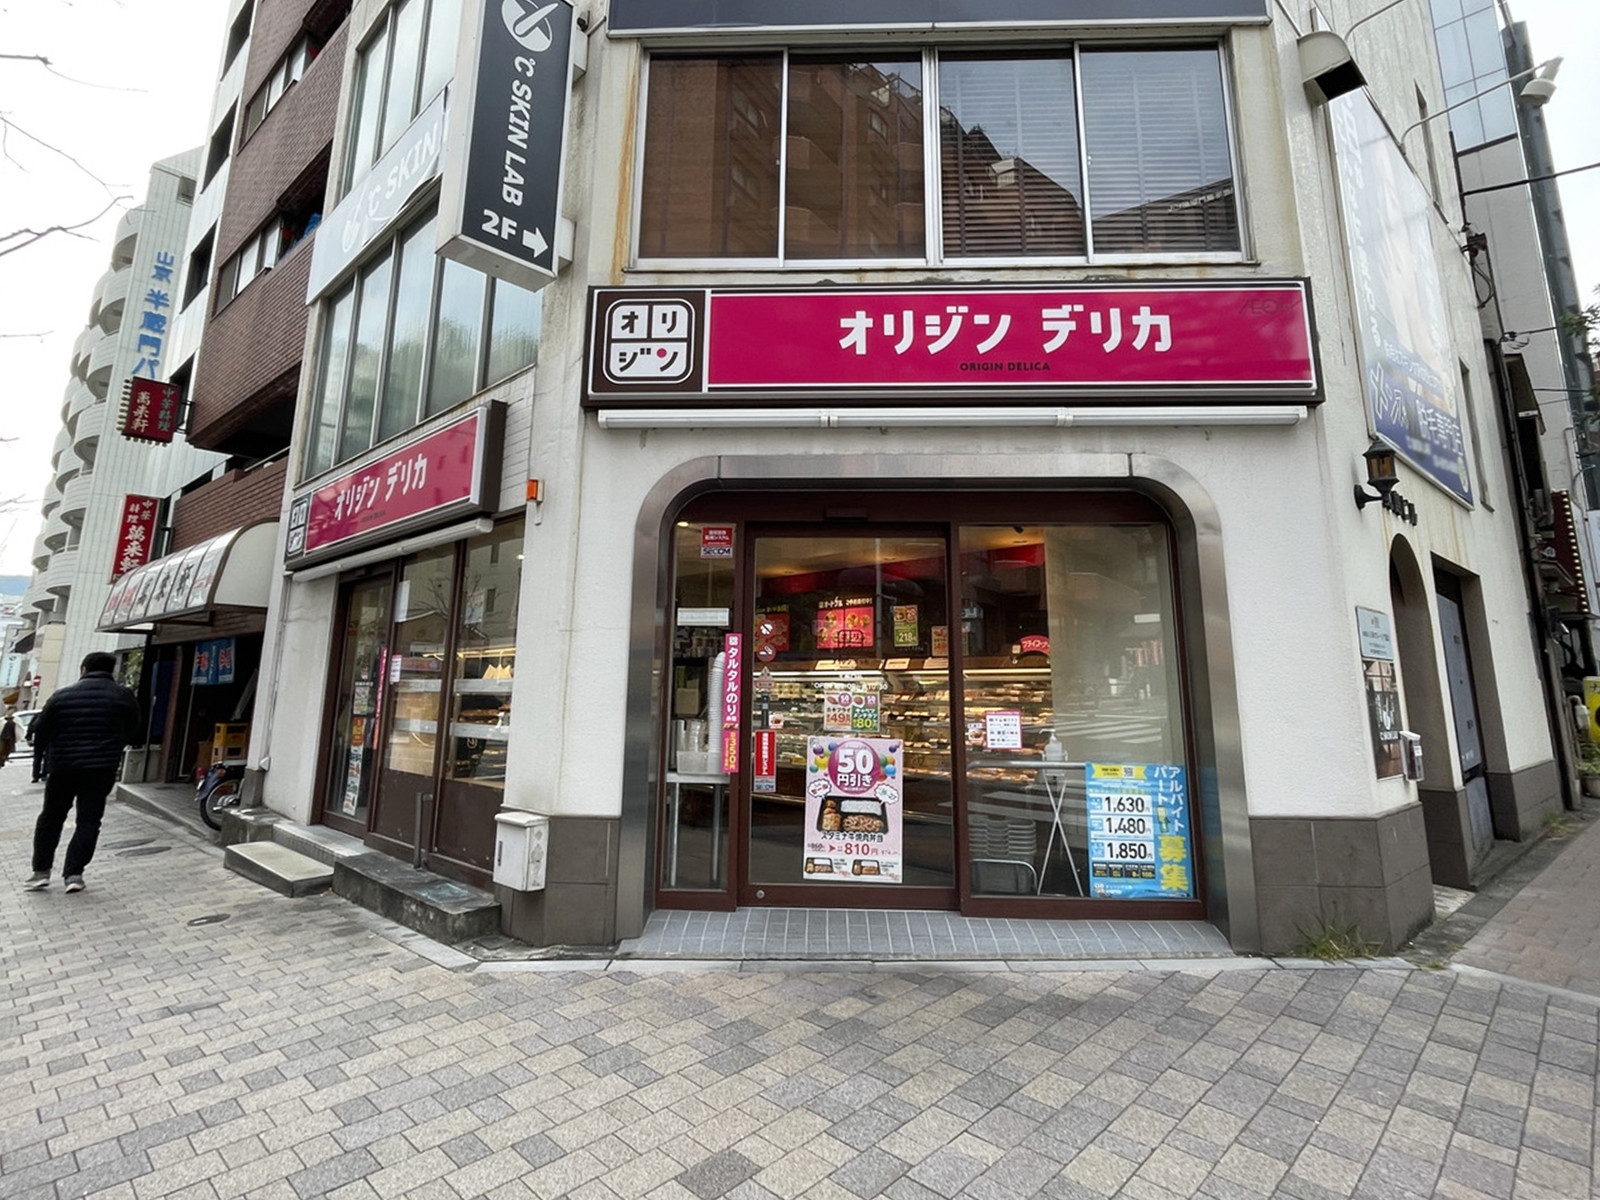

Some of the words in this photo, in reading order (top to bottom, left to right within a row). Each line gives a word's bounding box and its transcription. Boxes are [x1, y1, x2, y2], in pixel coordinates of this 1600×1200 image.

[508, 79, 532, 149] SKIN
[502, 150, 526, 207] LAB
[481, 209, 517, 240] 2F
[839, 305, 1012, 355] オリジン
[1041, 304, 1173, 353] デリカ
[959, 362, 1004, 371] ORIGIN
[1007, 362, 1051, 371] DELICA
[335, 475, 381, 521] オリジン
[385, 453, 428, 501] デリカ
[837, 749, 874, 774] 50
[837, 774, 872, 787] 円引き
[1153, 765, 1169, 805] パート
[1168, 766, 1185, 832] アルバイト
[1158, 835, 1189, 891] 募集
